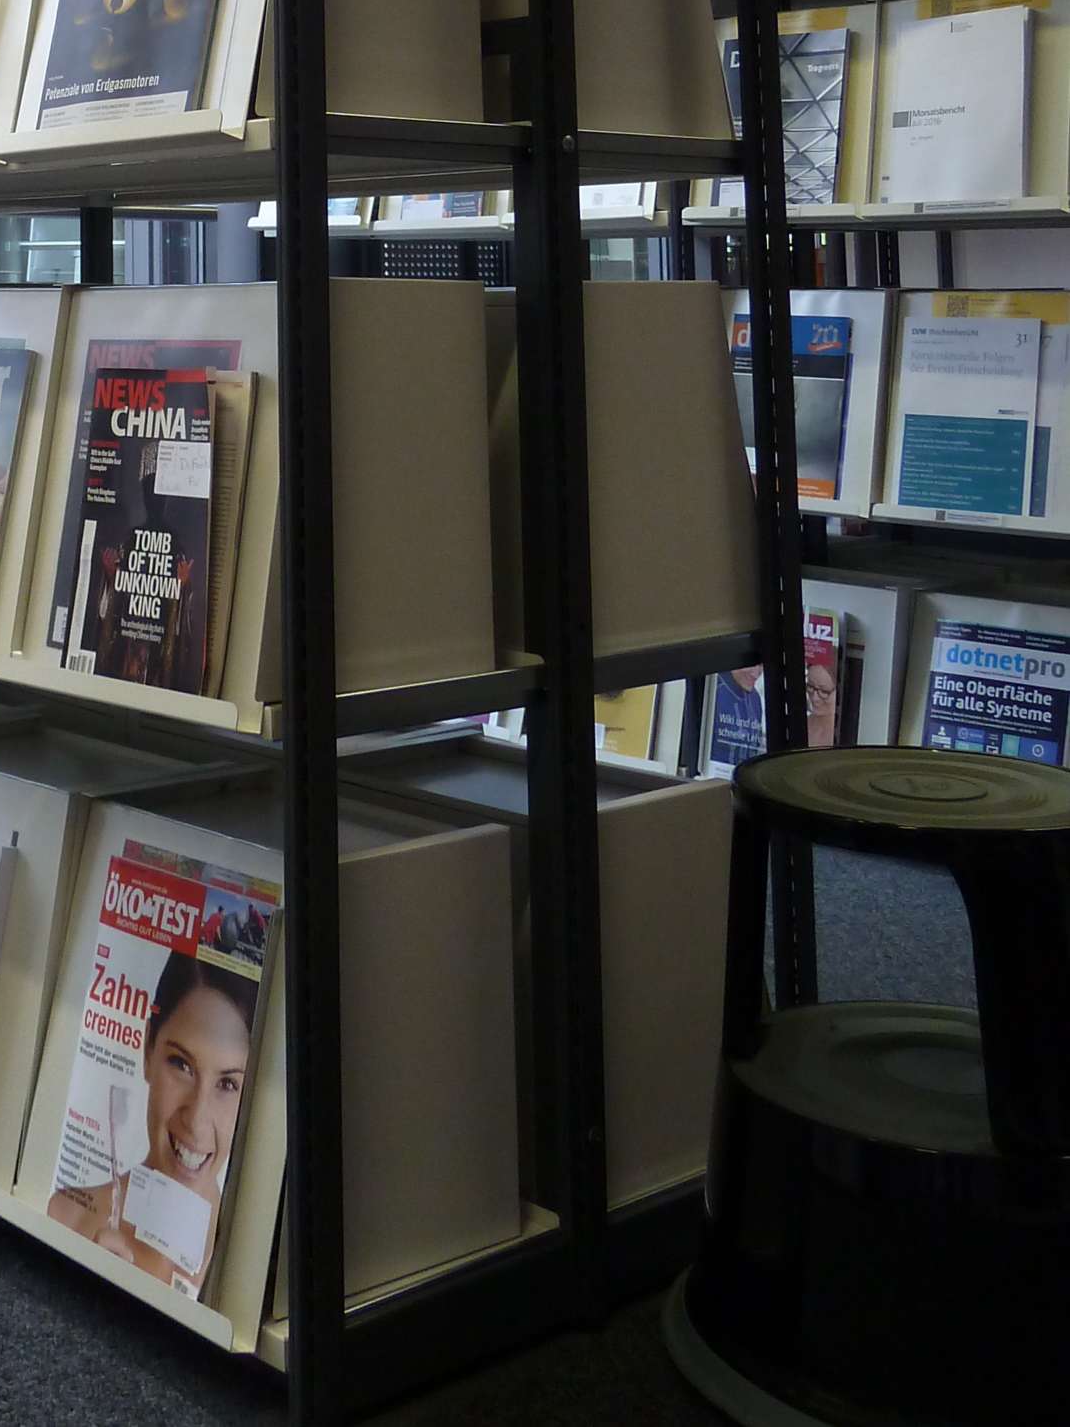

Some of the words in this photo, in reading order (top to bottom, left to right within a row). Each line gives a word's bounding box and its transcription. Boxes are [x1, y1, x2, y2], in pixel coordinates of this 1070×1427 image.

[81, 82, 95, 93] von
[95, 74, 160, 93] Erdgasmotoren
[1014, 333, 1028, 348] 31
[94, 378, 167, 410] NEWS
[110, 406, 188, 440] CHINA
[134, 529, 172, 554] TOMB
[128, 550, 147, 572] OF
[148, 553, 174, 577] THE
[114, 569, 182, 601] UNKNOWN
[128, 593, 162, 620] KING
[946, 643, 1066, 680] dotnetpro
[933, 691, 955, 707] für
[955, 695, 984, 713] alle
[986, 700, 1052, 723] Systeme
[934, 676, 964, 692] Eine
[966, 680, 1053, 706] Oberfläche
[105, 871, 145, 921] ÖKO
[147, 894, 200, 939] TEST
[89, 962, 161, 1020] Zahn-
[84, 1008, 143, 1050] cremes
